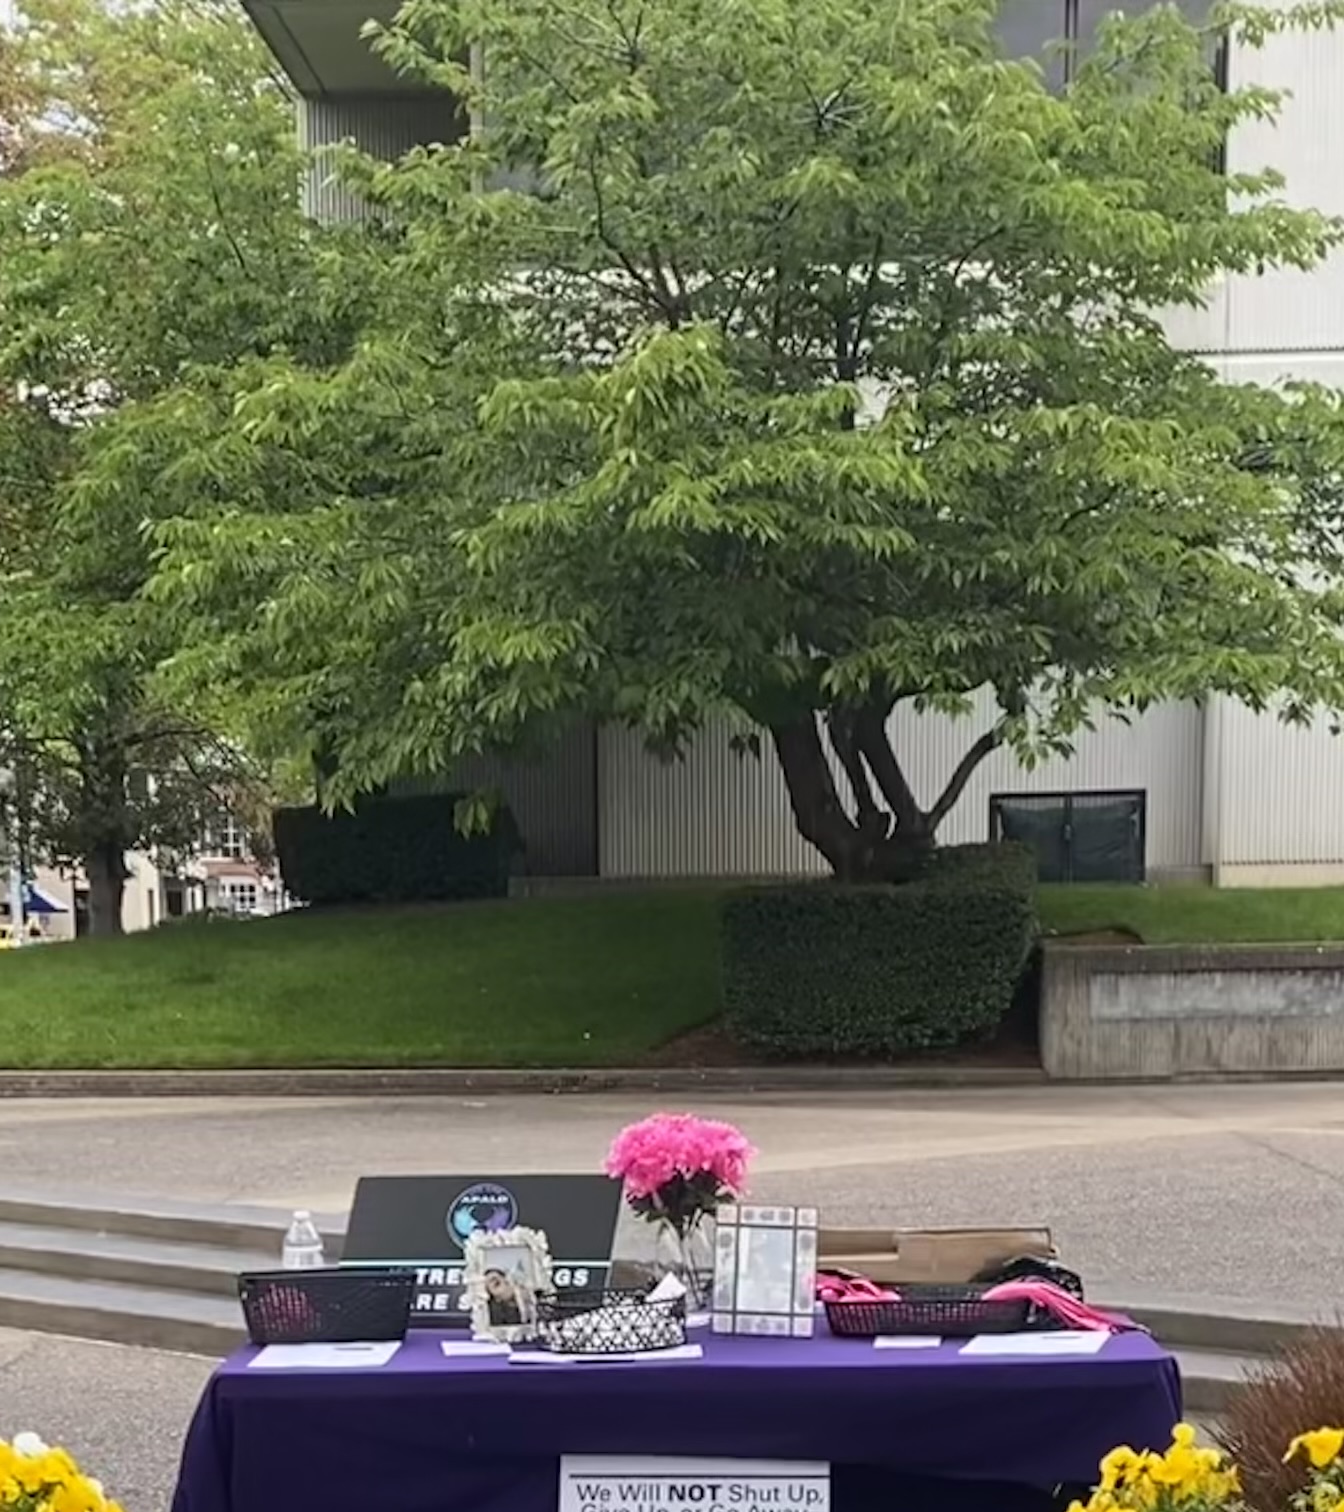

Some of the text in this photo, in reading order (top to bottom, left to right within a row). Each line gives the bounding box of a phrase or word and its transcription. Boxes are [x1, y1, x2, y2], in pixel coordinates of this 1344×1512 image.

[576, 1483, 824, 1506] We Will NOT Shut Up,
